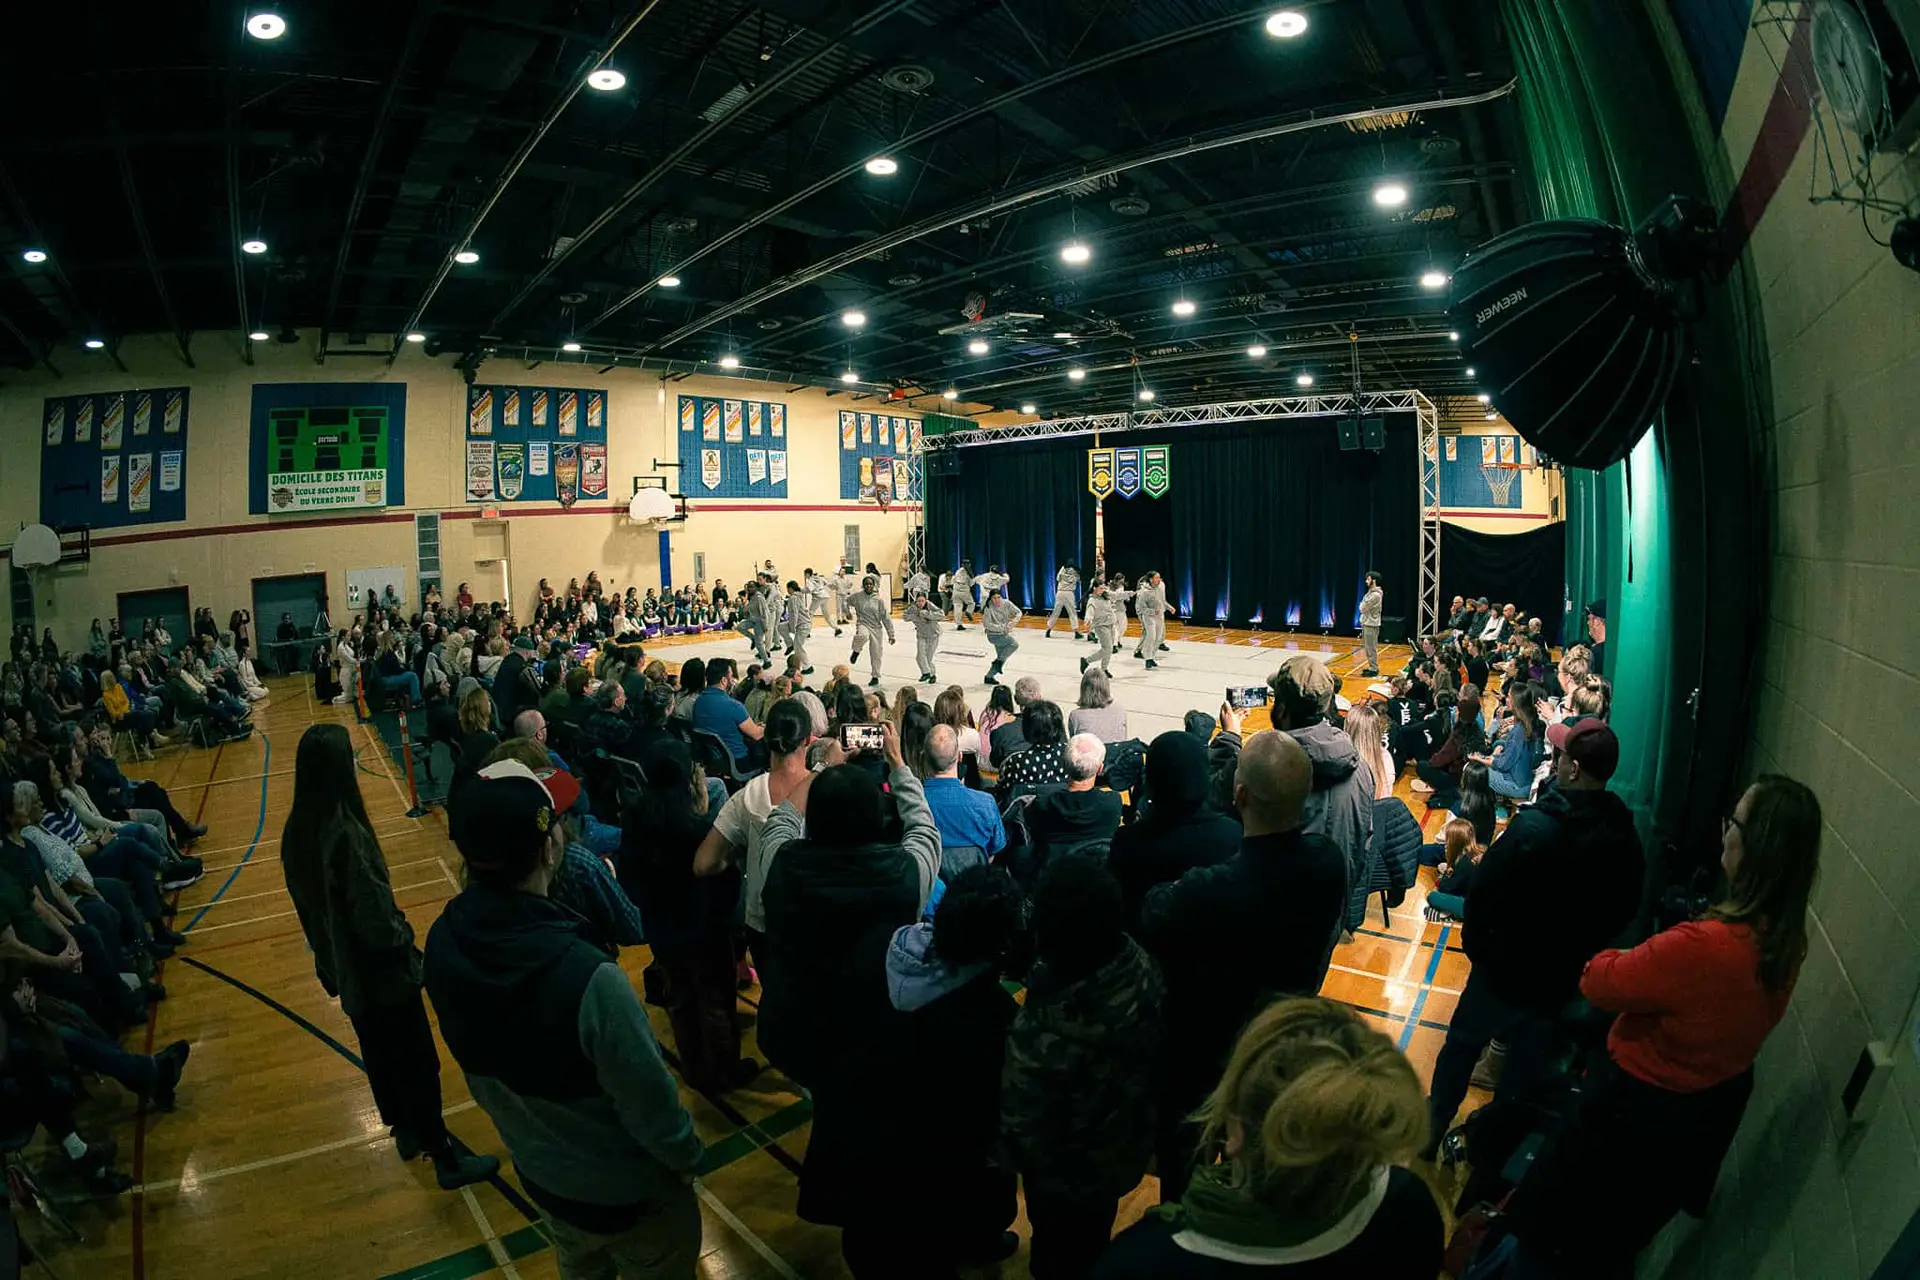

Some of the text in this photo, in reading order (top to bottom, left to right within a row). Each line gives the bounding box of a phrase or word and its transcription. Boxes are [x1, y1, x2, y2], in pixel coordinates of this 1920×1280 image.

[1476, 287, 1528, 324] NEEWER
[272, 470, 383, 485] DOMICILE DES TITANS
[317, 486, 360, 495] SECONDAIRE
[336, 495, 355, 504] DIVIN
